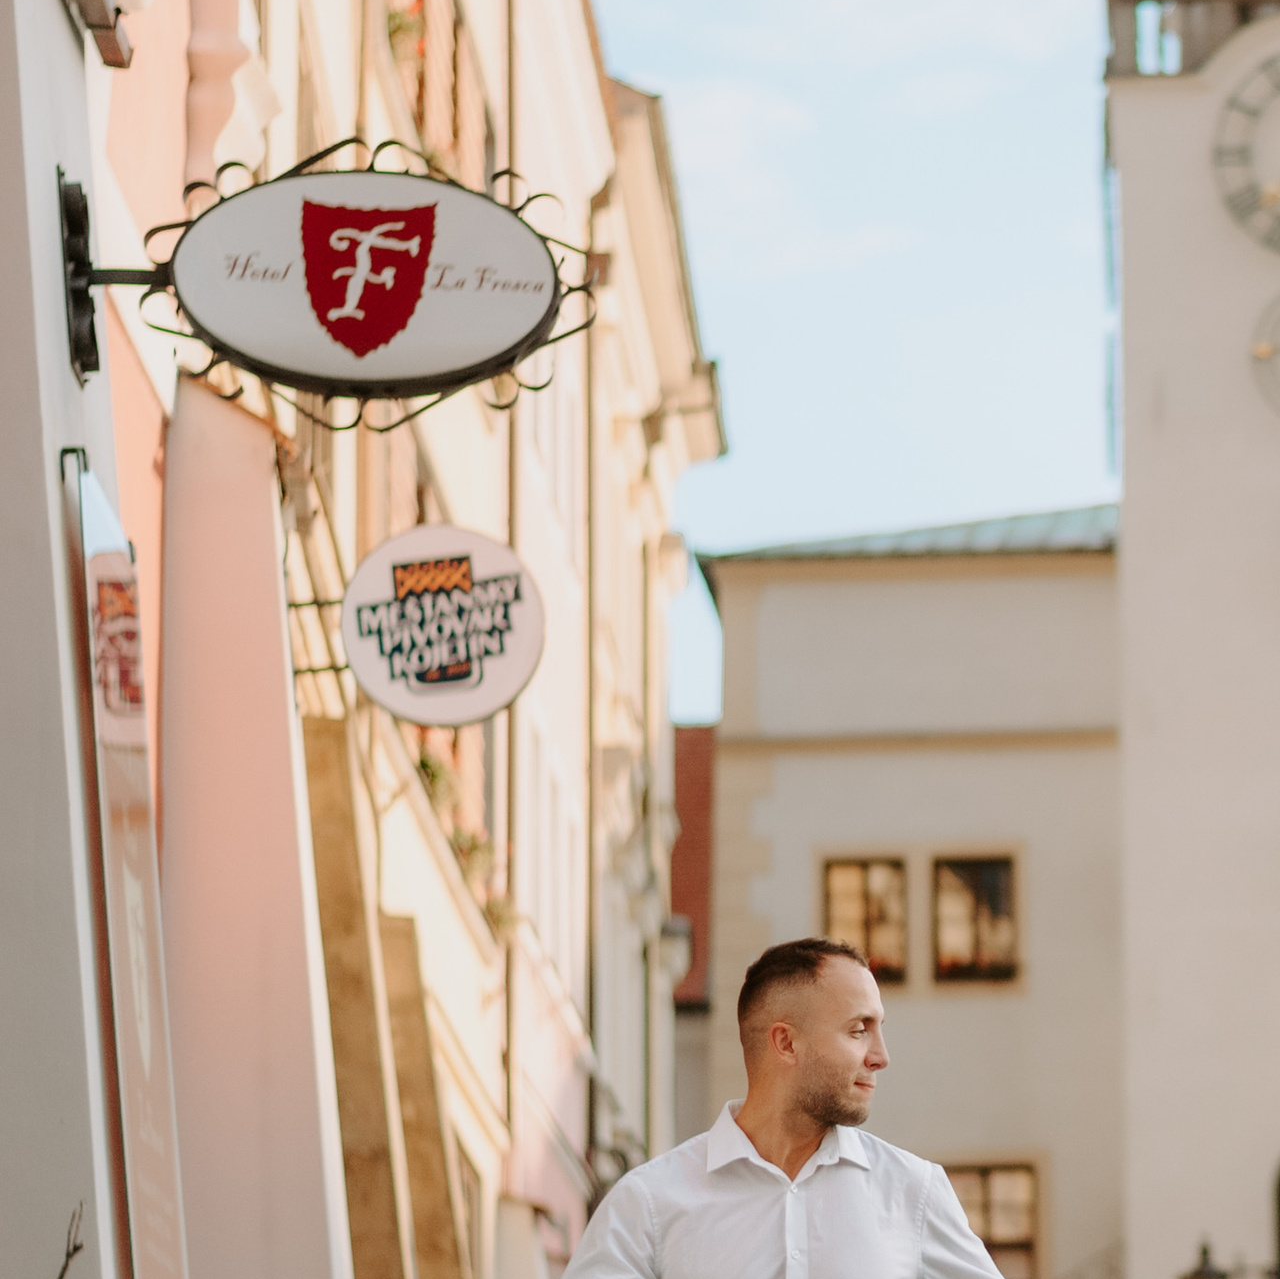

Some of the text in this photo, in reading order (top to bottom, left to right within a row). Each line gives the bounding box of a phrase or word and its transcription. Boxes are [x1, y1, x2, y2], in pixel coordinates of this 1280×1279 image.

[224, 250, 294, 281] Hotel
[429, 264, 466, 292] La
[329, 221, 420, 321] F
